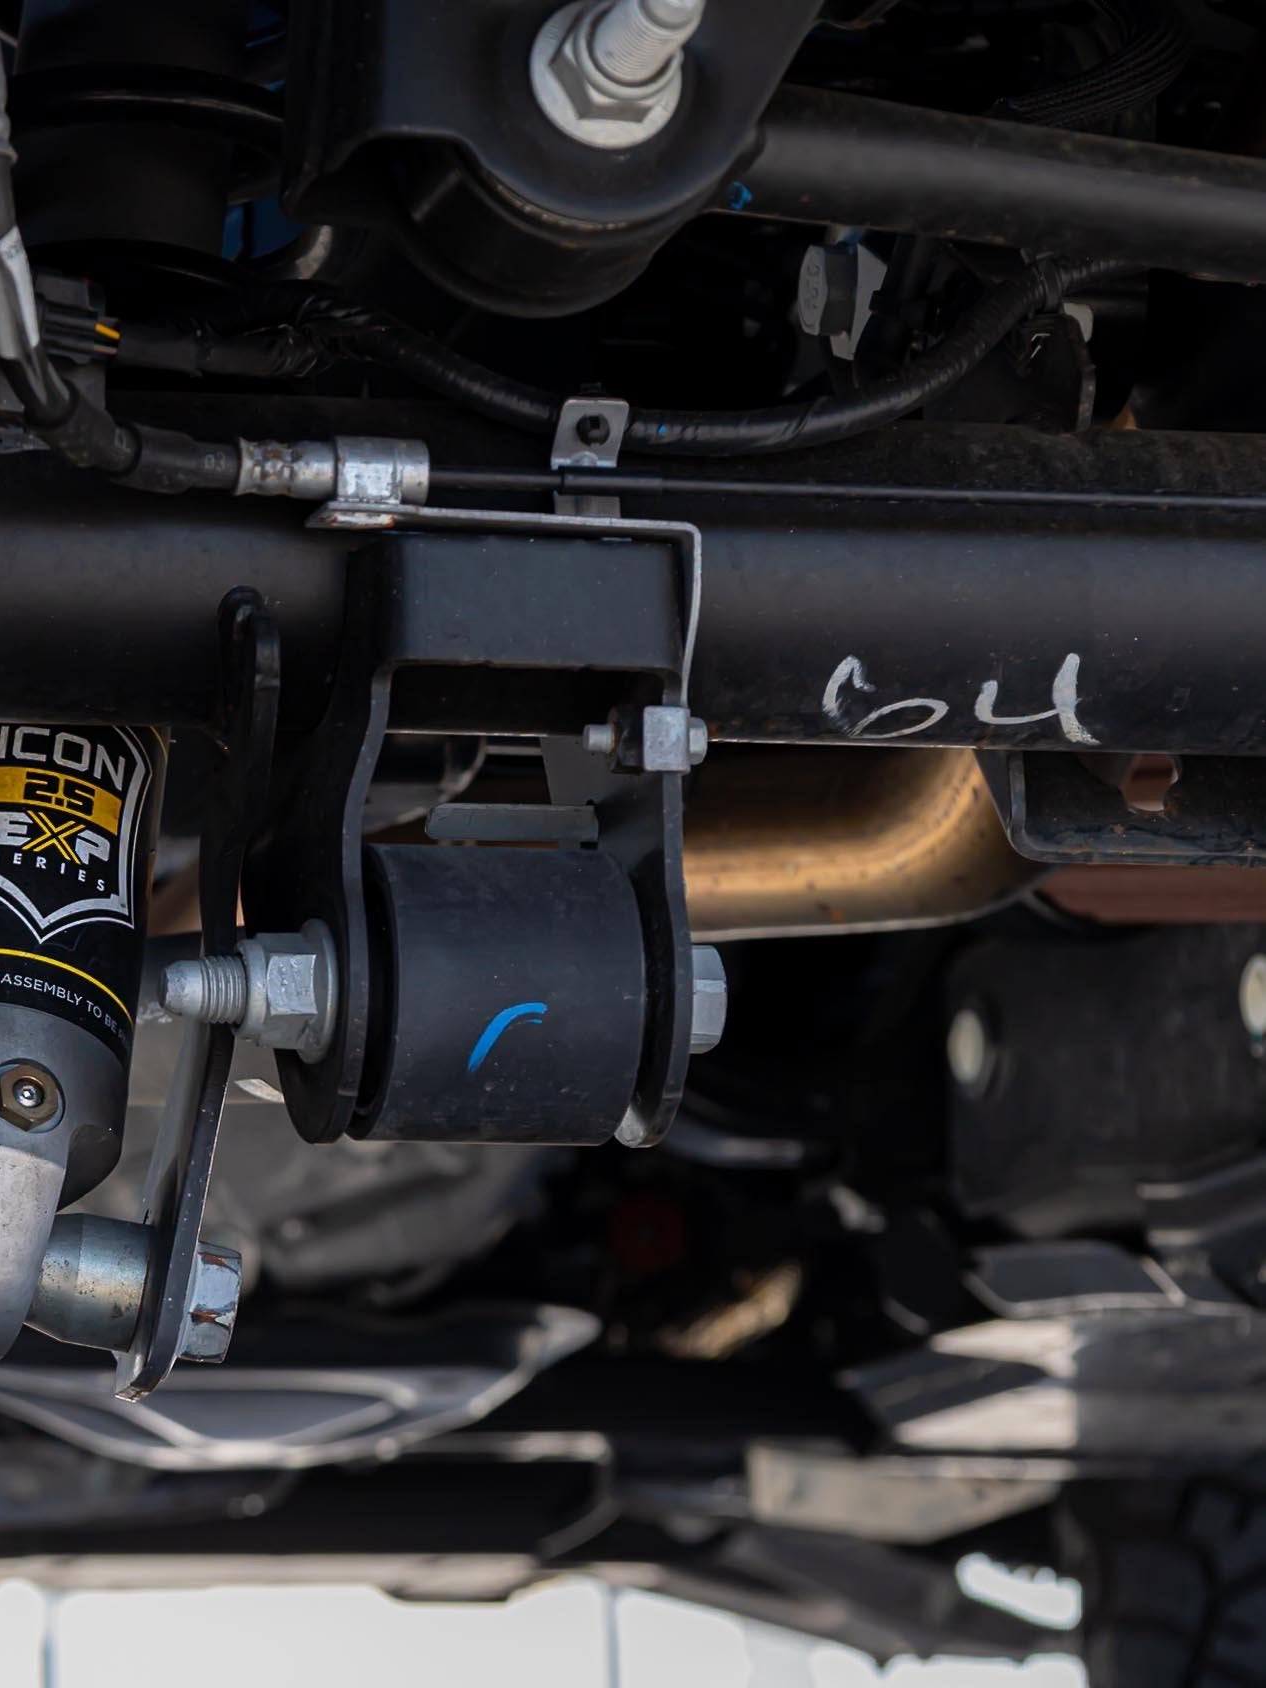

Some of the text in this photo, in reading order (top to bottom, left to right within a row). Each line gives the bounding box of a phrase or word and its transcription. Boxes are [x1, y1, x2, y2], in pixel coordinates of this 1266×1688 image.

[22, 770, 96, 817] 2.5
[86, 1000, 102, 1019] TO
[104, 1013, 118, 1035] BE
